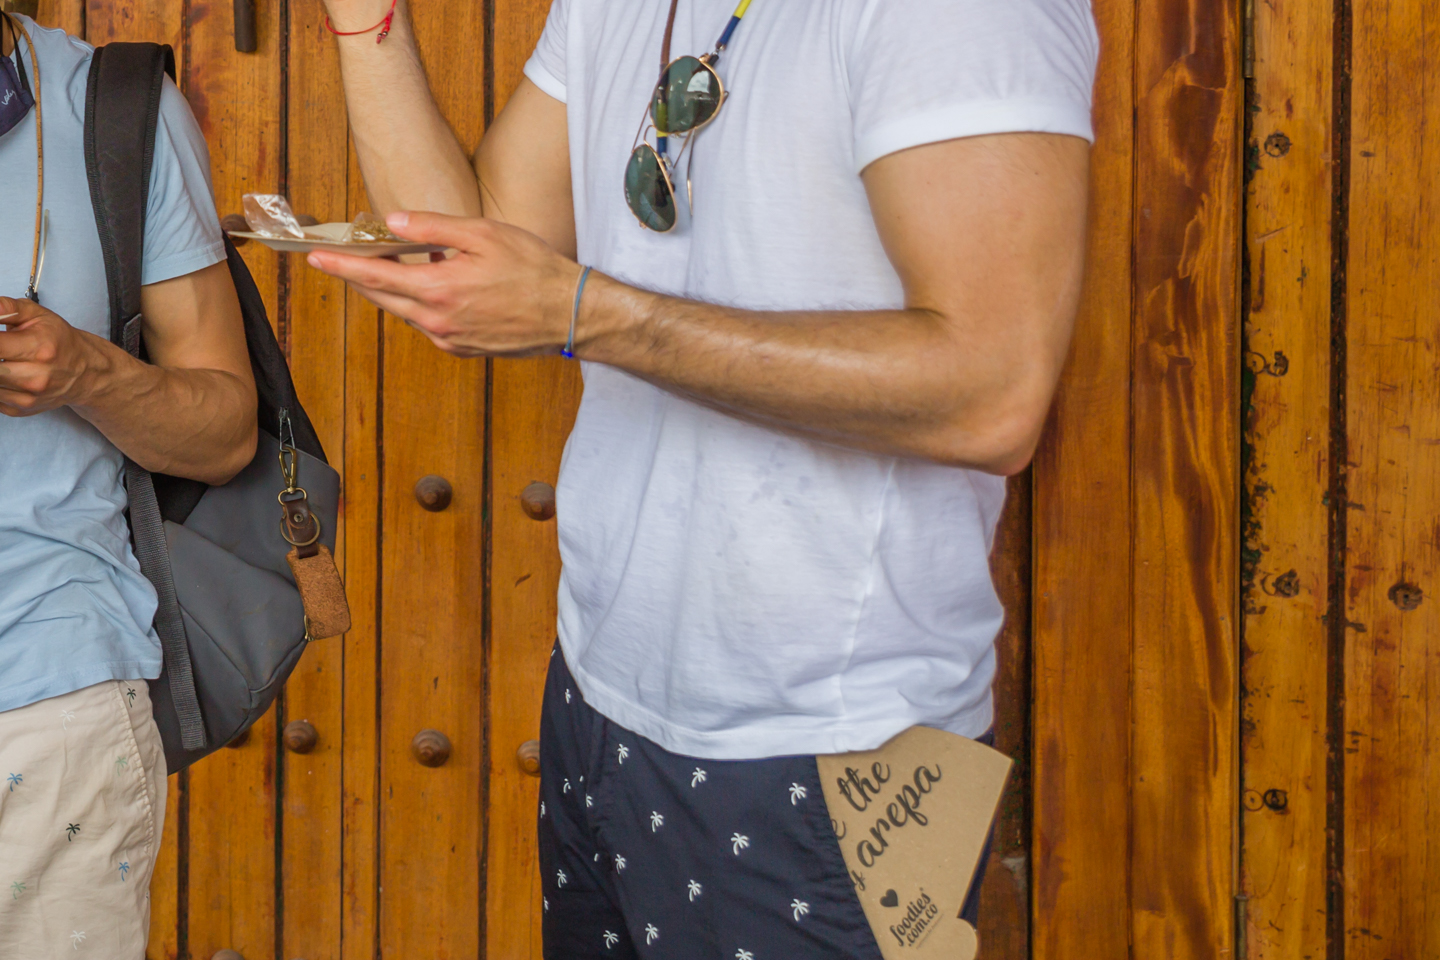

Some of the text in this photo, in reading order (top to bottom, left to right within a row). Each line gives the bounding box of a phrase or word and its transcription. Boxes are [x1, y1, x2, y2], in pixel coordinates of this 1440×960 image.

[836, 761, 891, 812] the
[856, 763, 942, 868] arepa
[889, 891, 931, 947] foodies
